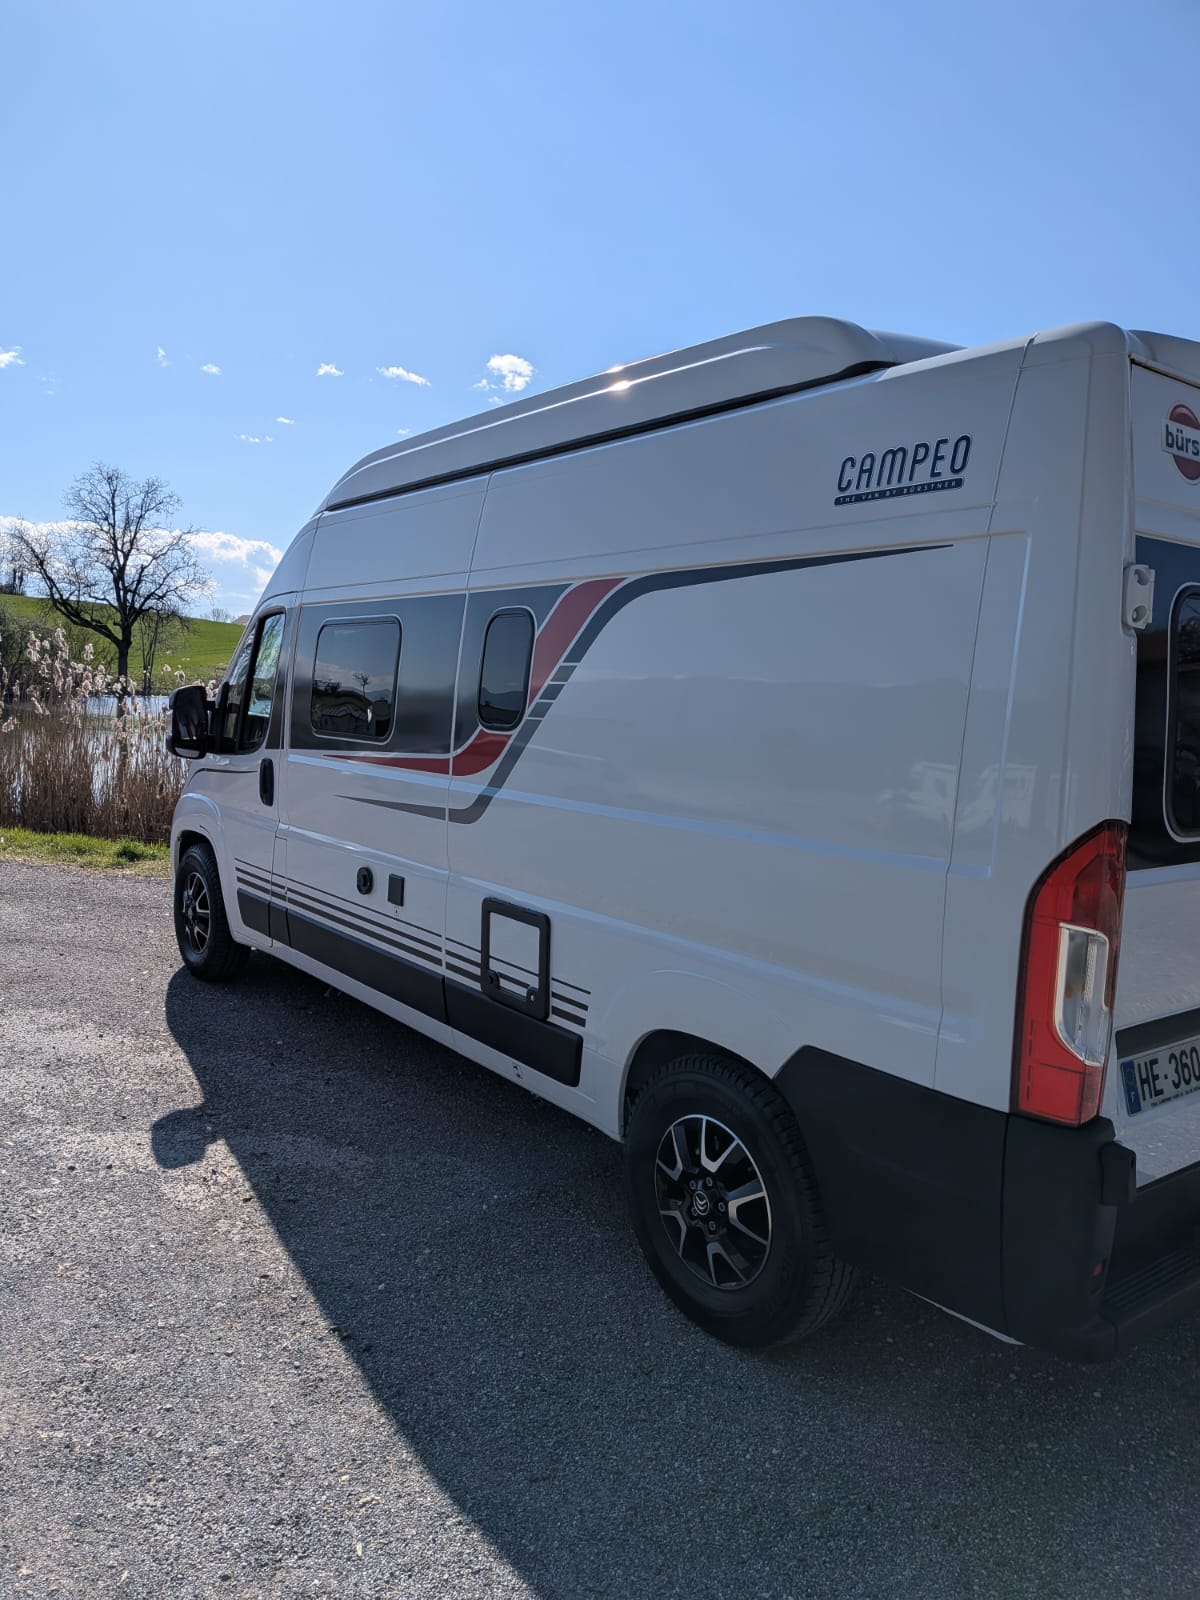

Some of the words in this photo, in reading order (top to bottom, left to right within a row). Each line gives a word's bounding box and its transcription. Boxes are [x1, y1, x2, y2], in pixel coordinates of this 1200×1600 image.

[837, 434, 971, 493] CAMPEO
[839, 495, 856, 504] THE
[861, 492, 879, 501] VAN
